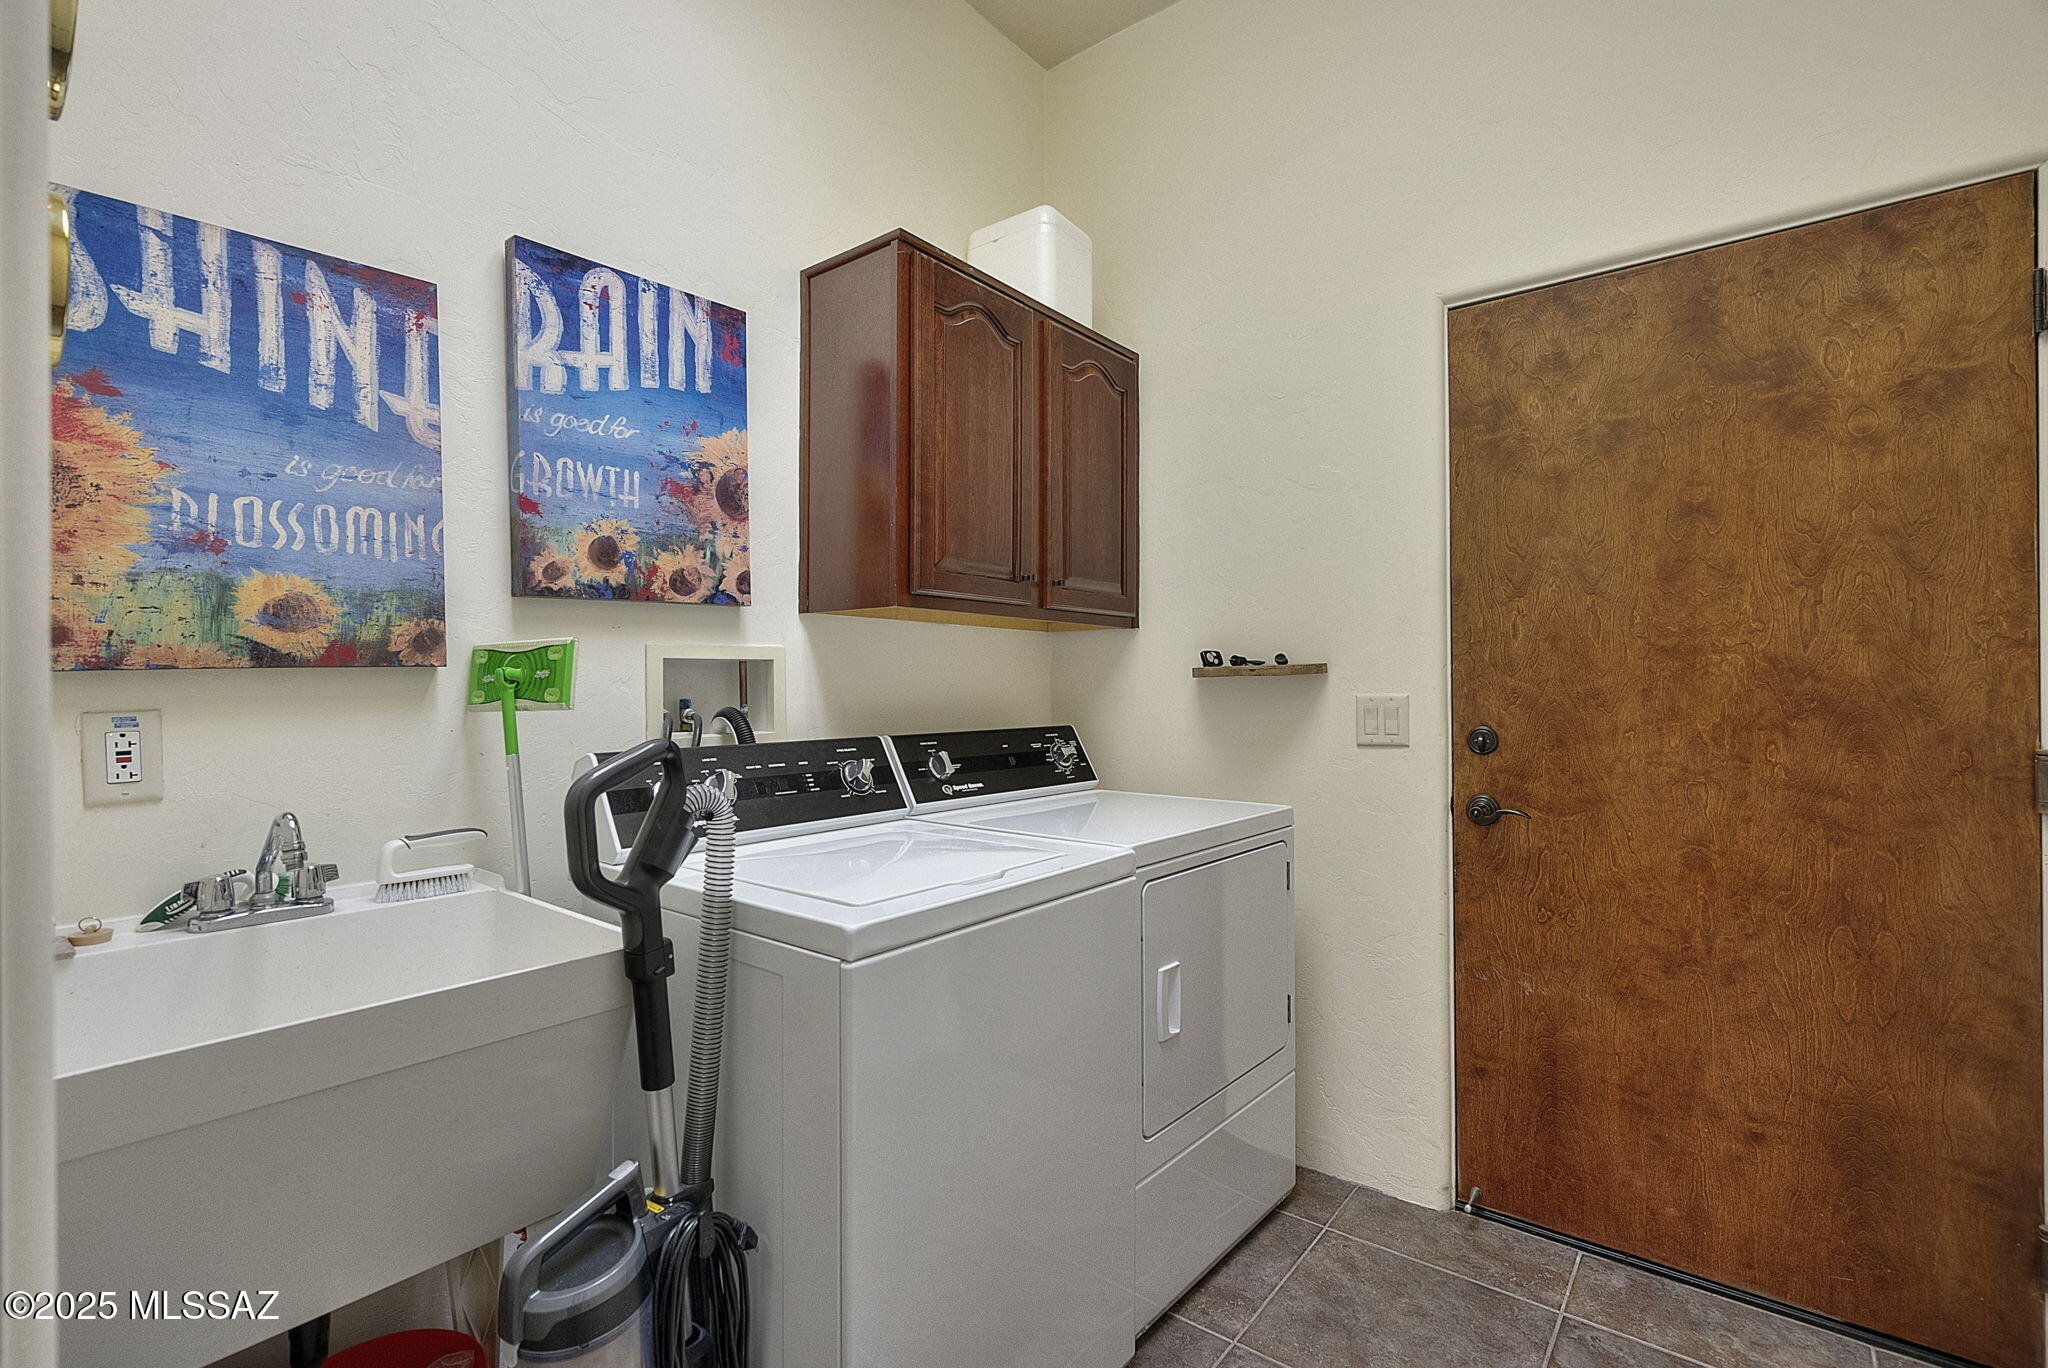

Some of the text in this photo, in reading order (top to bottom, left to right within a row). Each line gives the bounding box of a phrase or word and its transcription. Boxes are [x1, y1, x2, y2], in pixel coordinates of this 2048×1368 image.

[514, 256, 713, 395] RAIN
[519, 404, 640, 439] is good for
[284, 454, 441, 493] is good for
[511, 450, 640, 509] GROWTH
[165, 899, 188, 912] LIBM
